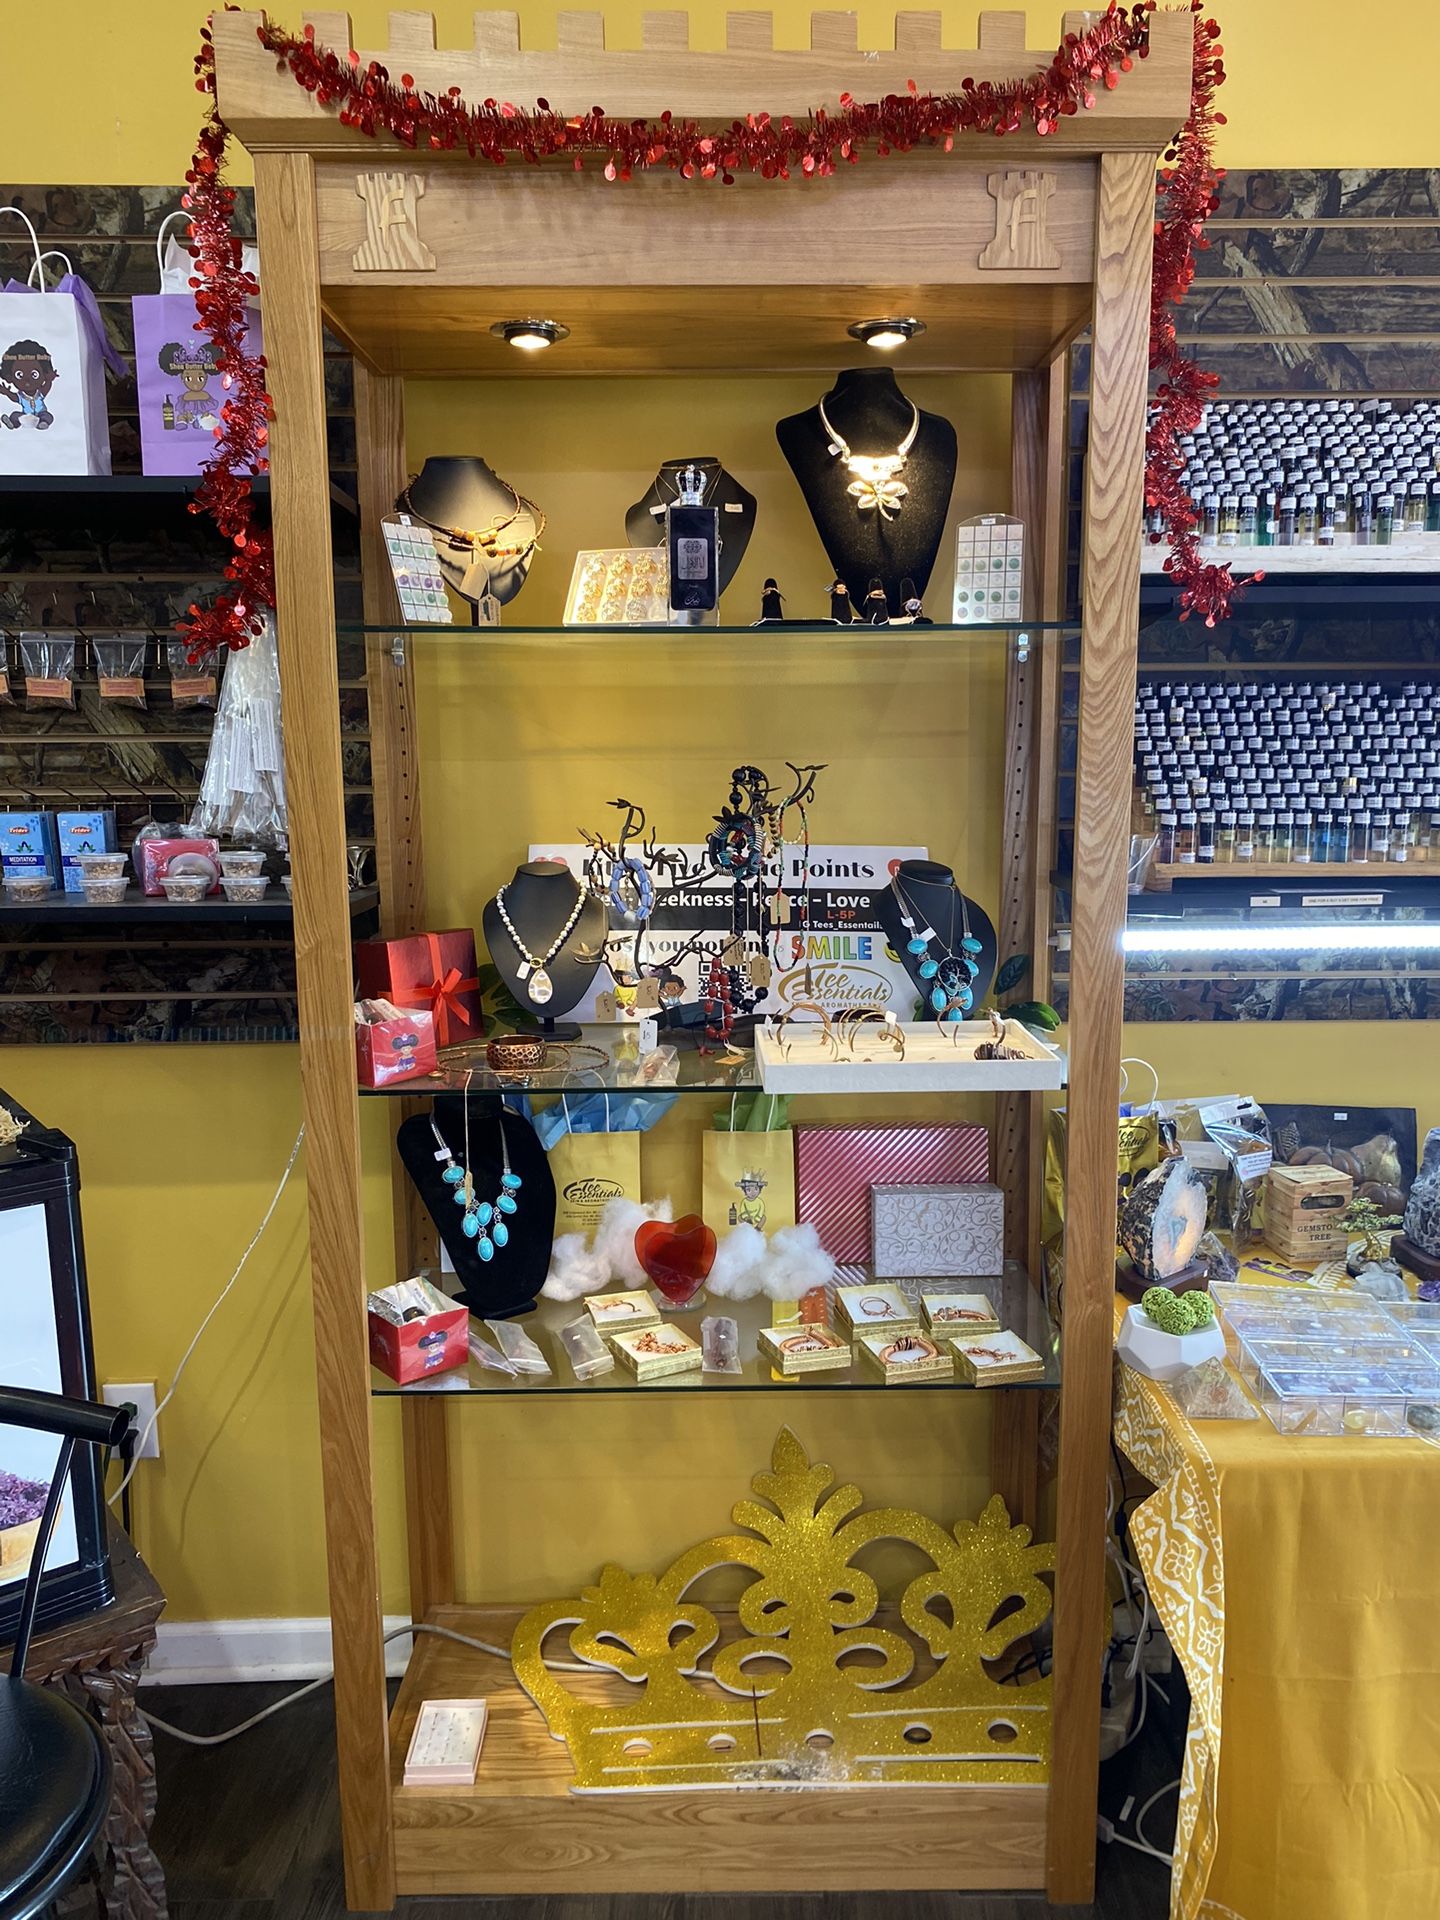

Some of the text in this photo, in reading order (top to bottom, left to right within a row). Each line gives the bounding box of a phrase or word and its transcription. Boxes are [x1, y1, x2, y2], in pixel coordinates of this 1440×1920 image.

[793, 859, 875, 878] Points
[826, 892, 870, 908] Love
[827, 911, 856, 919] L-5P
[791, 935, 873, 960] SMILE
[791, 981, 889, 1001] Essentials
[569, 1186, 621, 1200] Essentials
[1310, 1233, 1332, 1242] TREE
